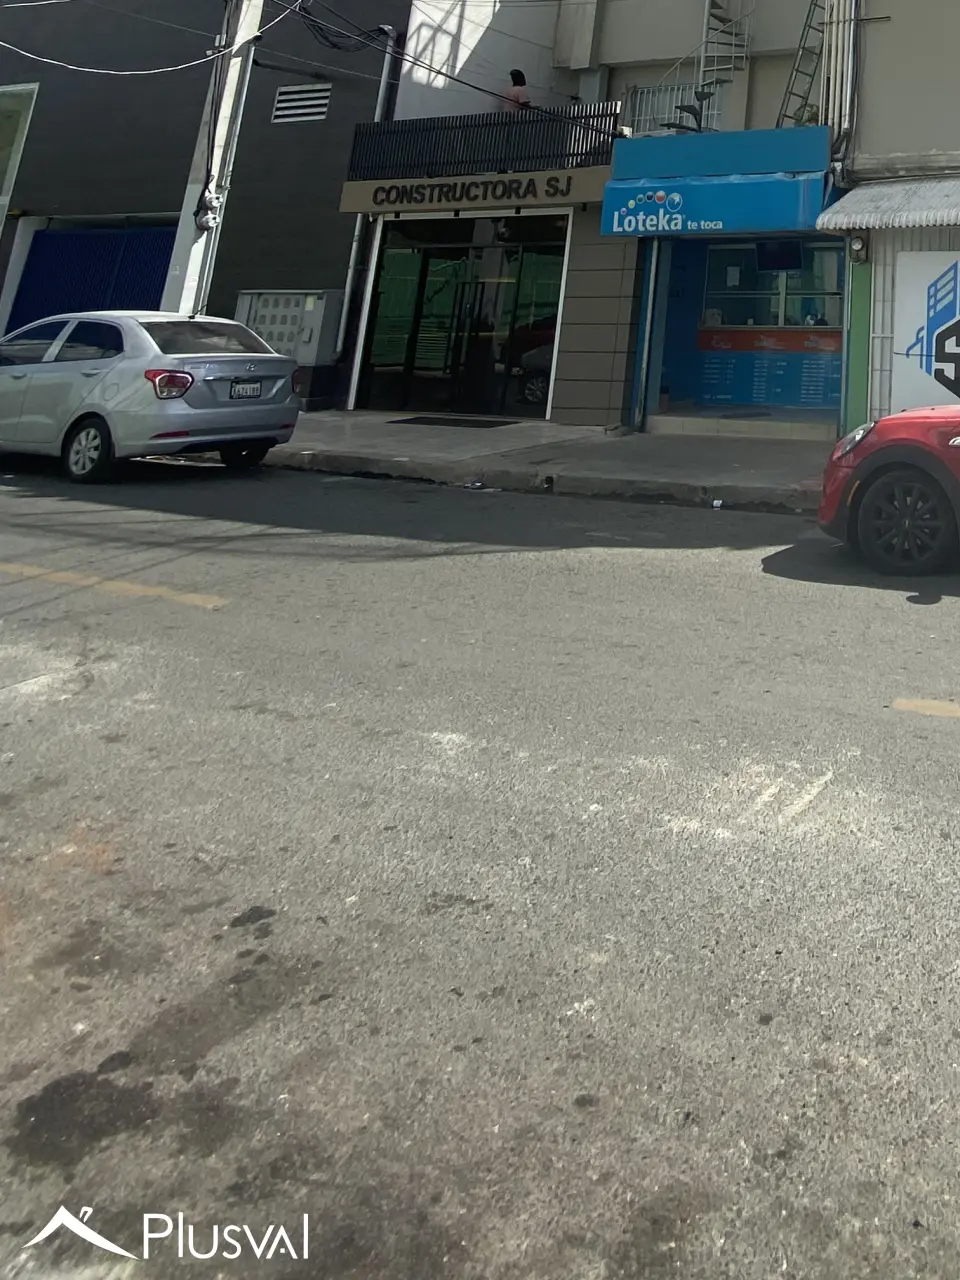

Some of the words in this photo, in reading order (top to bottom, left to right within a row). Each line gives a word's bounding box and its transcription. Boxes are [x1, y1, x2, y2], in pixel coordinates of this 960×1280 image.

[372, 178, 538, 205] CONSTRUCTORA
[545, 176, 573, 197] SJ
[613, 208, 682, 232] Loteka
[687, 220, 698, 230] te
[700, 220, 723, 229] toca
